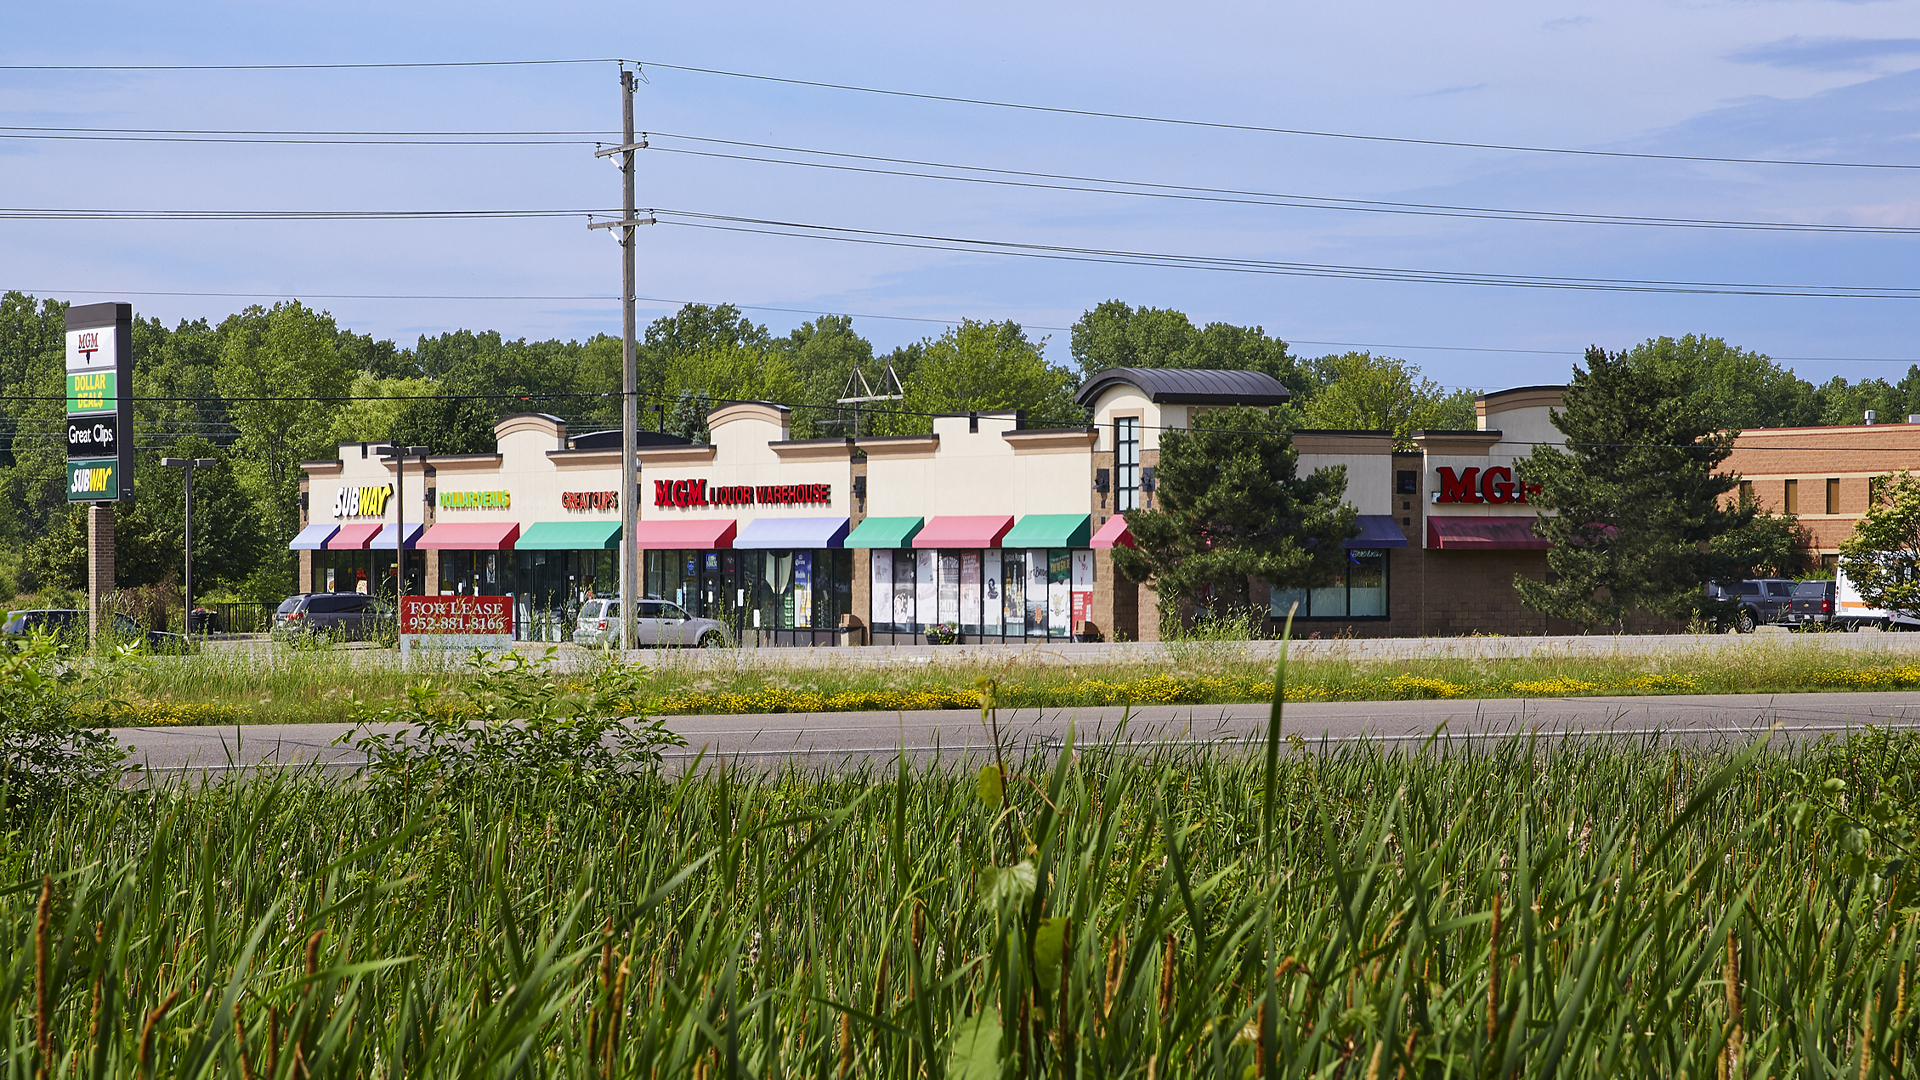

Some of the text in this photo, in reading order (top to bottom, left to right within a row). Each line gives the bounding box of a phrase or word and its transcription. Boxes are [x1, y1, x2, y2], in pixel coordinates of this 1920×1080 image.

[78, 332, 99, 350] MGM
[74, 374, 106, 391] DOLLAR
[68, 424, 113, 447] Great Clips
[71, 466, 113, 494] SUBWAY
[332, 483, 394, 518] SUBWAY
[439, 492, 476, 507] DOLLAR
[562, 490, 618, 509] GREAT CLIPS
[653, 479, 831, 507] MGM LIQUOR WAREHOUSE
[409, 602, 504, 615] FOR LEASE
[409, 617, 504, 630] 952-881-8166
